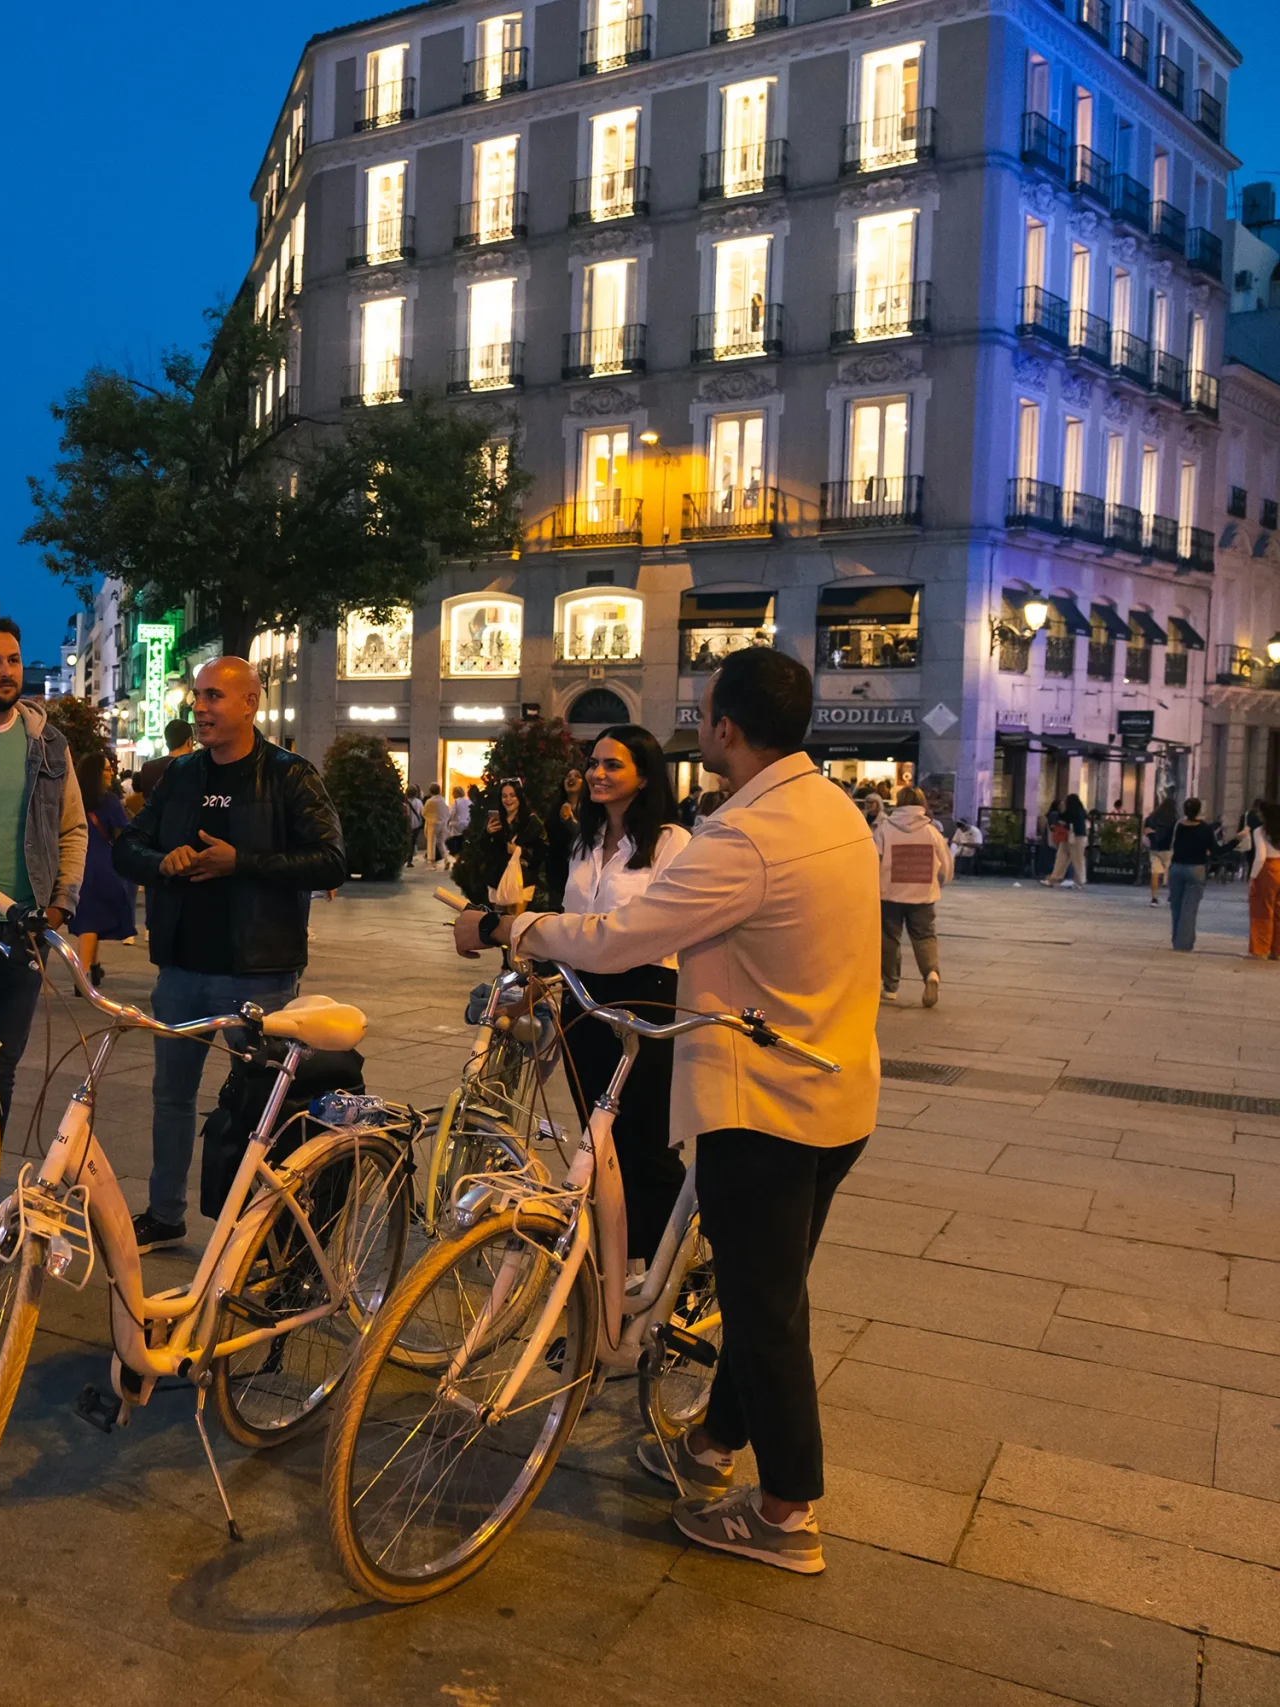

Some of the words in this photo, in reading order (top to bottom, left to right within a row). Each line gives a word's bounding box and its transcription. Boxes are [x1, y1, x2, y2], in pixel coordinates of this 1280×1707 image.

[815, 708, 915, 724] RODILLA
[579, 1140, 596, 1154] Biz
[86, 1159, 99, 1176] Bizi
[721, 1515, 753, 1540] N
